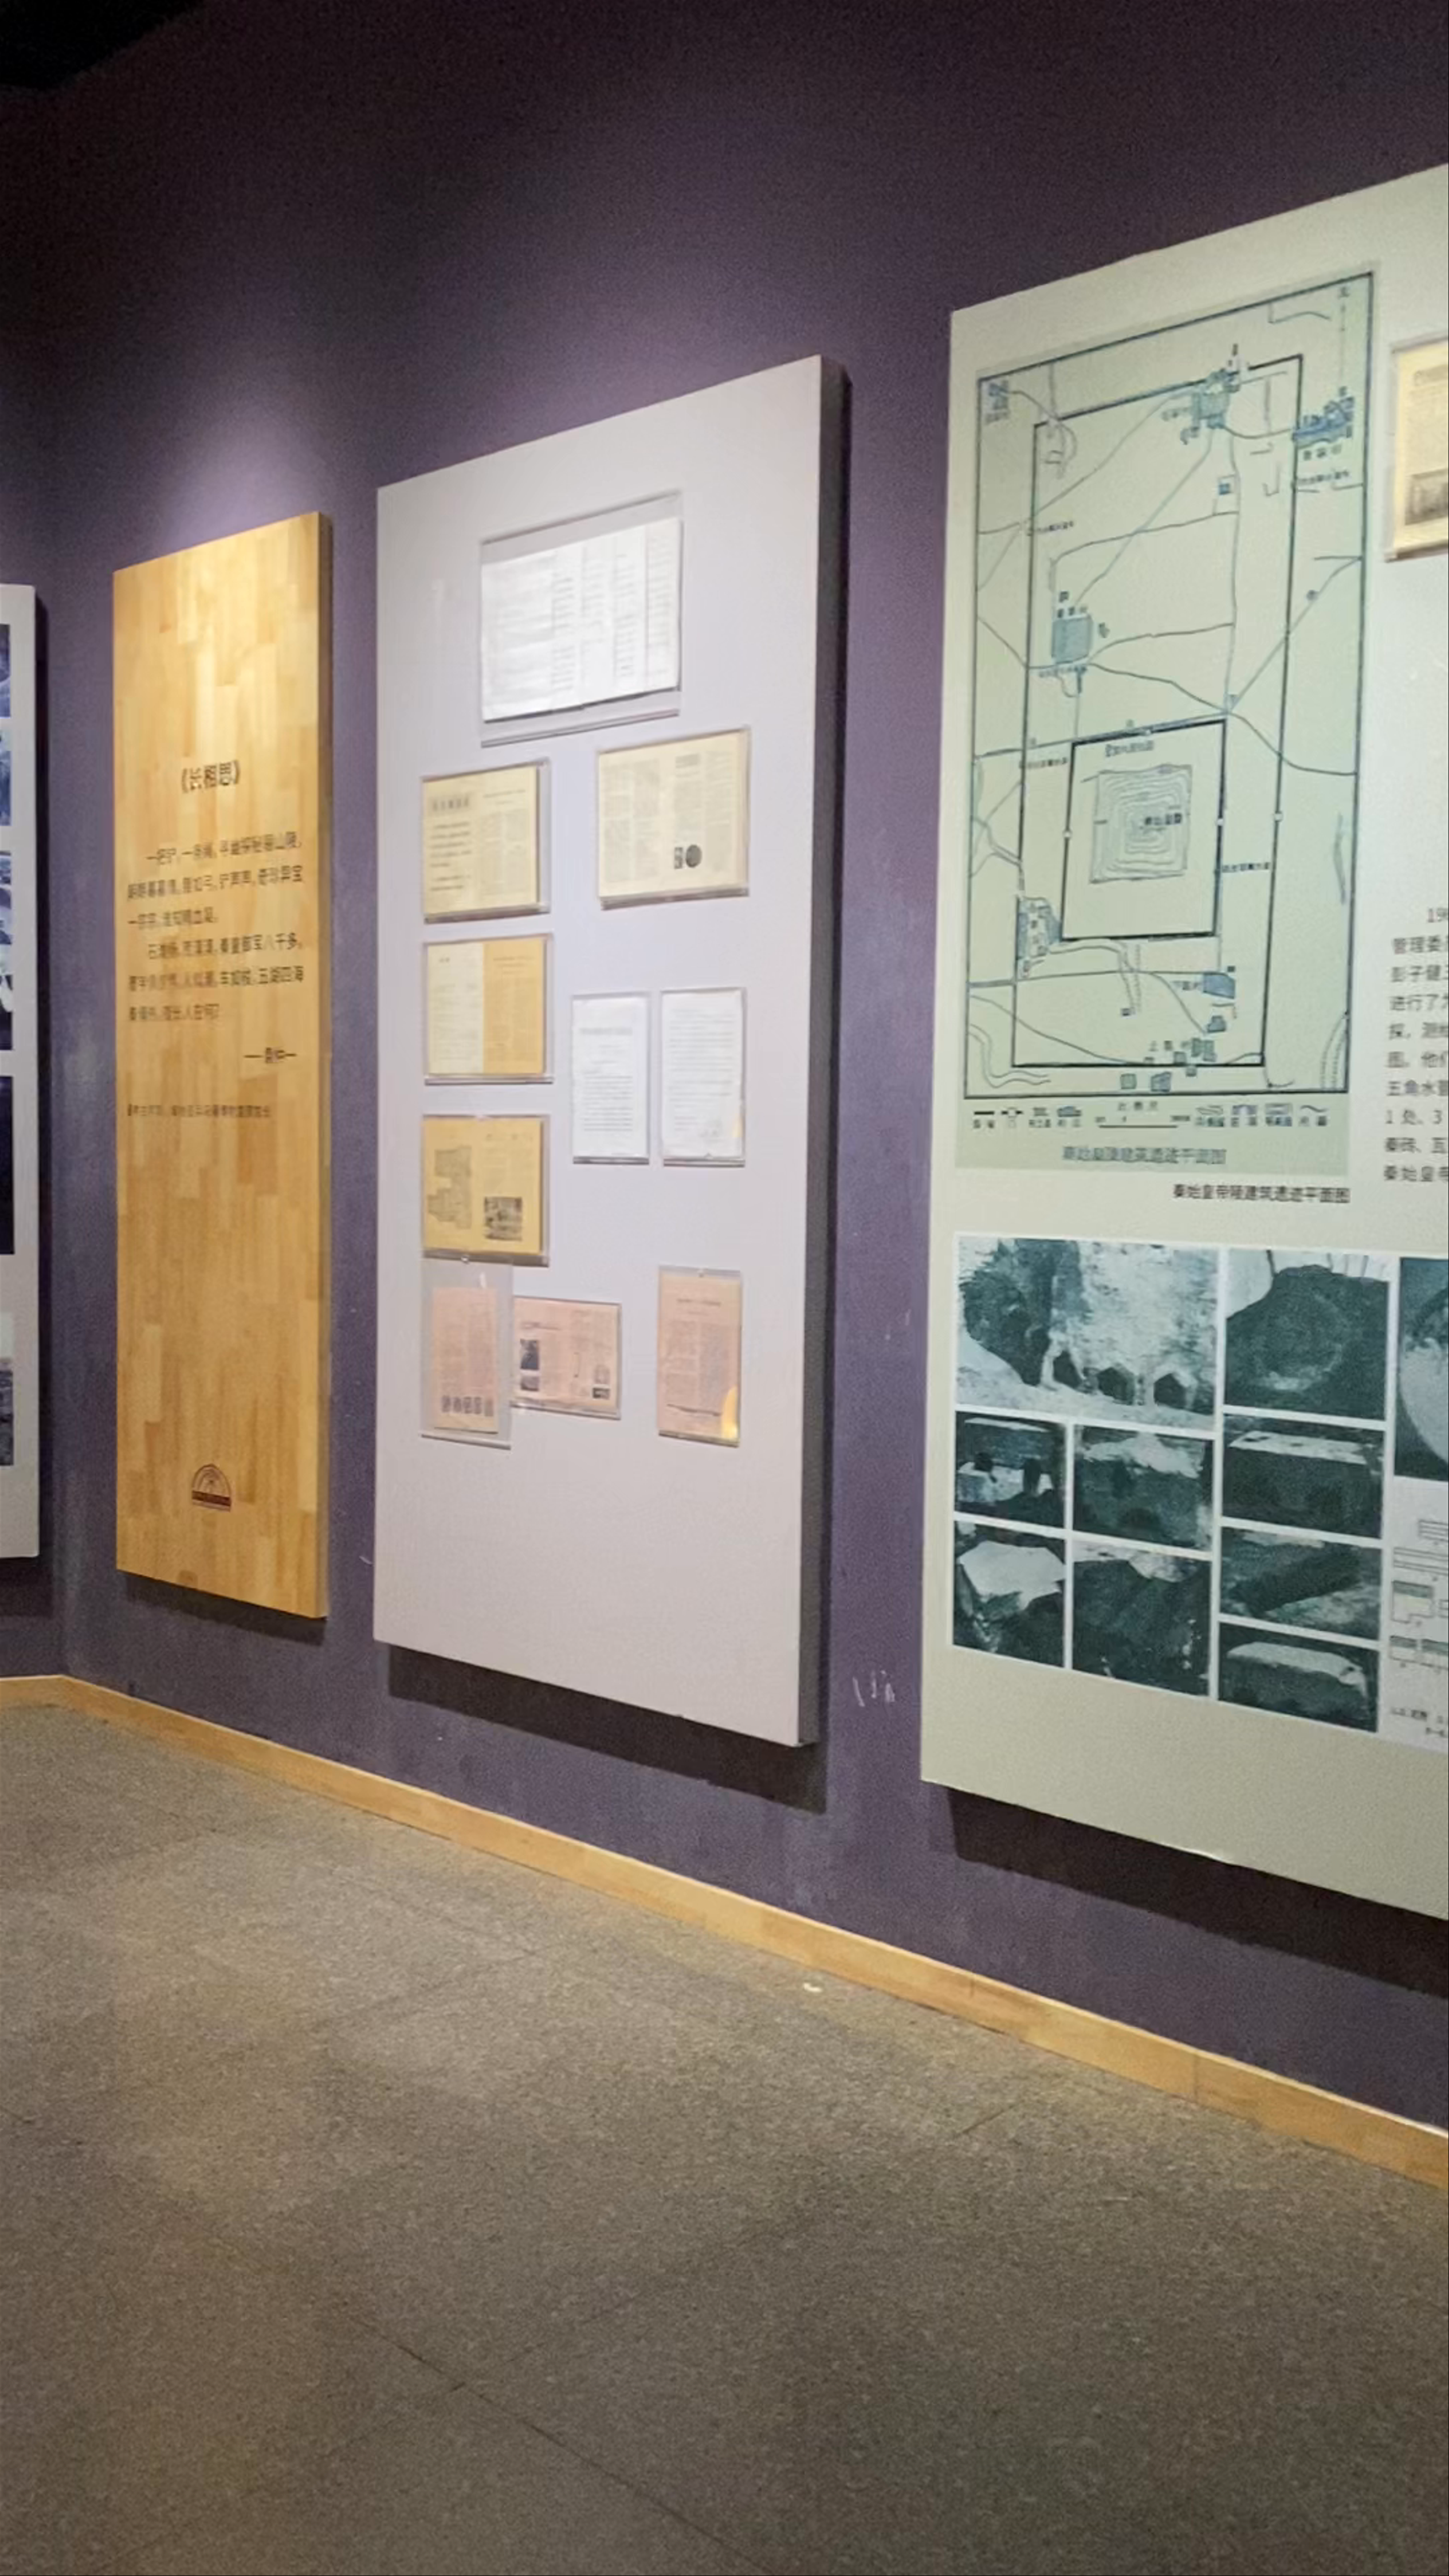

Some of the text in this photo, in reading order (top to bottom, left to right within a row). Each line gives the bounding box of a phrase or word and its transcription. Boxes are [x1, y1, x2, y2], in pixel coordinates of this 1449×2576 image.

[1174, 1184, 1351, 1204] 秦始皇帝陵建筑遗迹平面图
